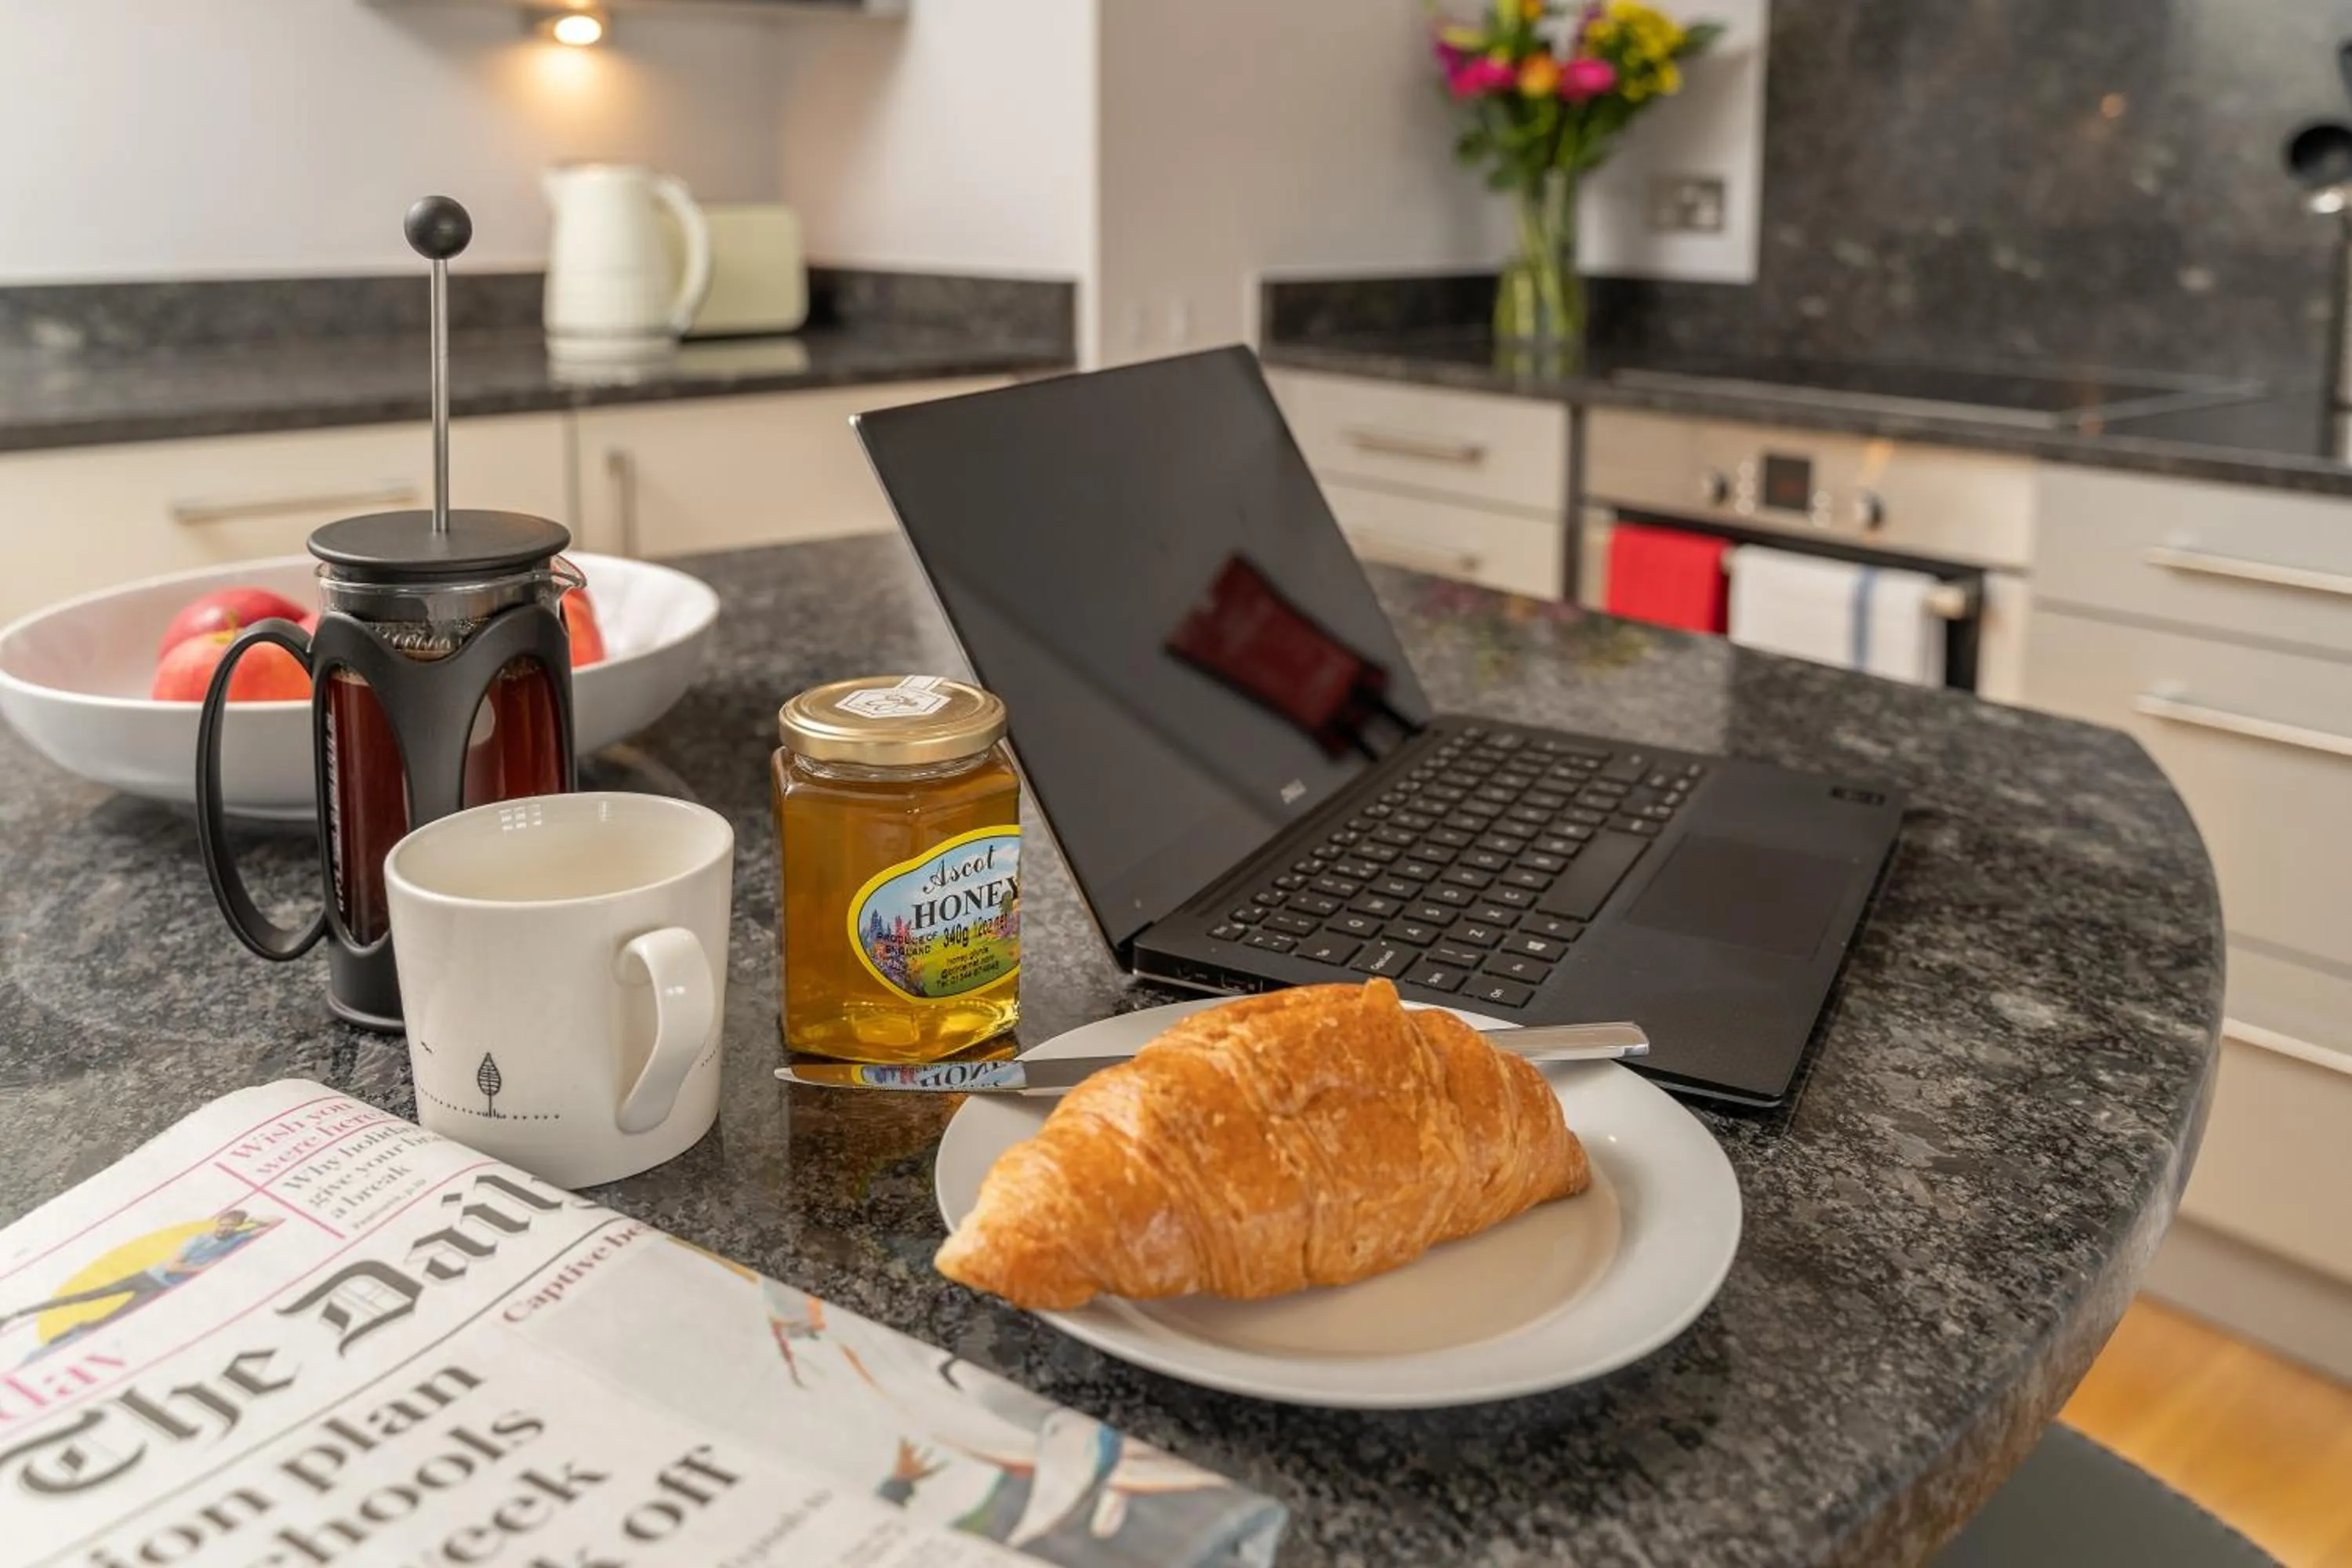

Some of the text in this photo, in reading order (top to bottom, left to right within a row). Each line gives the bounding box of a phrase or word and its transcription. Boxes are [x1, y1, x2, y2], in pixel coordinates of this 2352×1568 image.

[923, 844, 996, 895] Ascot
[885, 945, 931, 956] ENGLAND
[943, 923, 969, 948] 340g
[230, 1102, 354, 1159] Wish you
[256, 1135, 316, 1175] were
[282, 1156, 340, 1189] Why
[309, 1174, 353, 1208] give
[355, 1144, 403, 1177] your
[341, 1166, 413, 1209] break
[502, 1246, 613, 1323] Captive
[0, 1174, 600, 1494] The Dail
[280, 1364, 485, 1493] plan
[270, 1410, 546, 1568] hools
[427, 1461, 612, 1562] eek
[622, 1443, 742, 1543] off
